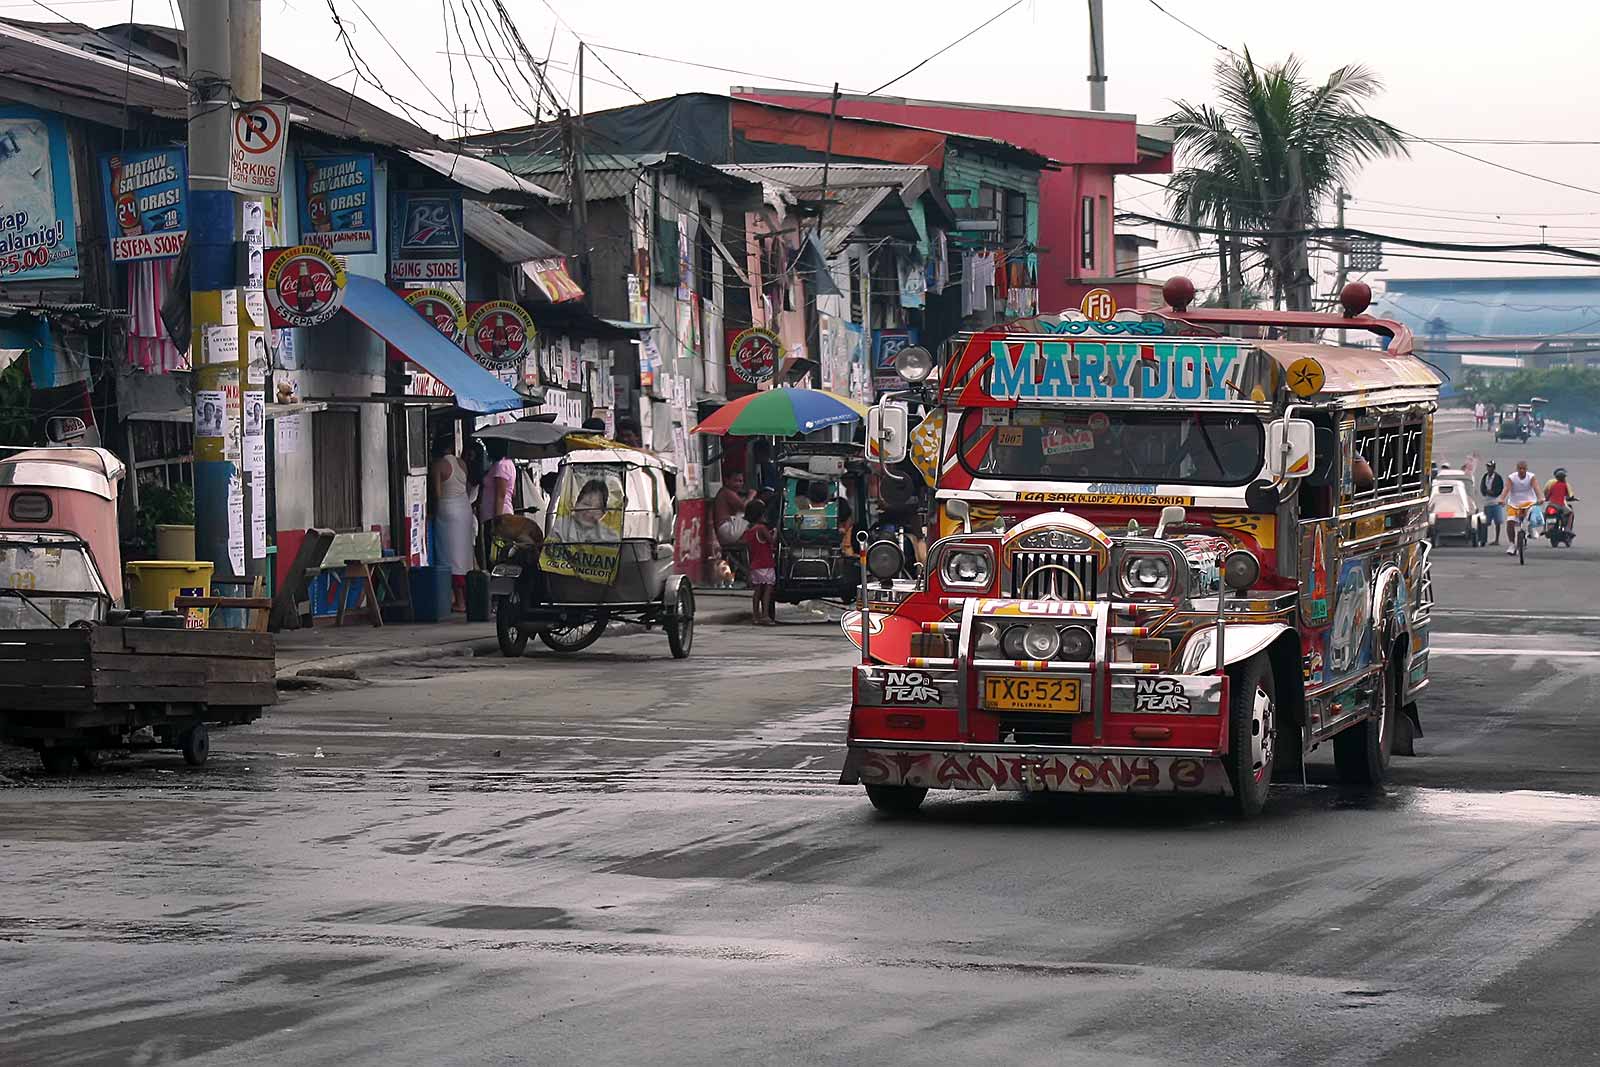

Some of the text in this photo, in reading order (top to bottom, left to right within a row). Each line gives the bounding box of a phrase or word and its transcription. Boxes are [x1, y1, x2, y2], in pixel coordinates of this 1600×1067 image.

[233, 148, 245, 161] NO
[125, 154, 167, 179] HATAW
[233, 161, 276, 178] PARKING
[319, 161, 356, 179] HATAW
[120, 179, 134, 194] SA
[233, 172, 275, 187] BOTH SIDES
[313, 180, 326, 194] SA
[118, 188, 180, 222] 24 ORAS!
[311, 192, 366, 219] 24 ORAS!
[113, 238, 152, 259] ESTEPA
[392, 261, 457, 278] AGING STORE
[275, 305, 314, 326] ESTEPA
[1041, 321, 1166, 336] MOTORS
[474, 347, 530, 371] AGING STORE
[990, 341, 1239, 401] MARY JOY
[559, 561, 611, 578] CONCILOR
[887, 672, 923, 686] NO
[1137, 680, 1174, 694] NO
[885, 685, 940, 701] FEAR
[1136, 694, 1190, 710] FEAR
[936, 754, 1160, 789] ANTHONY
